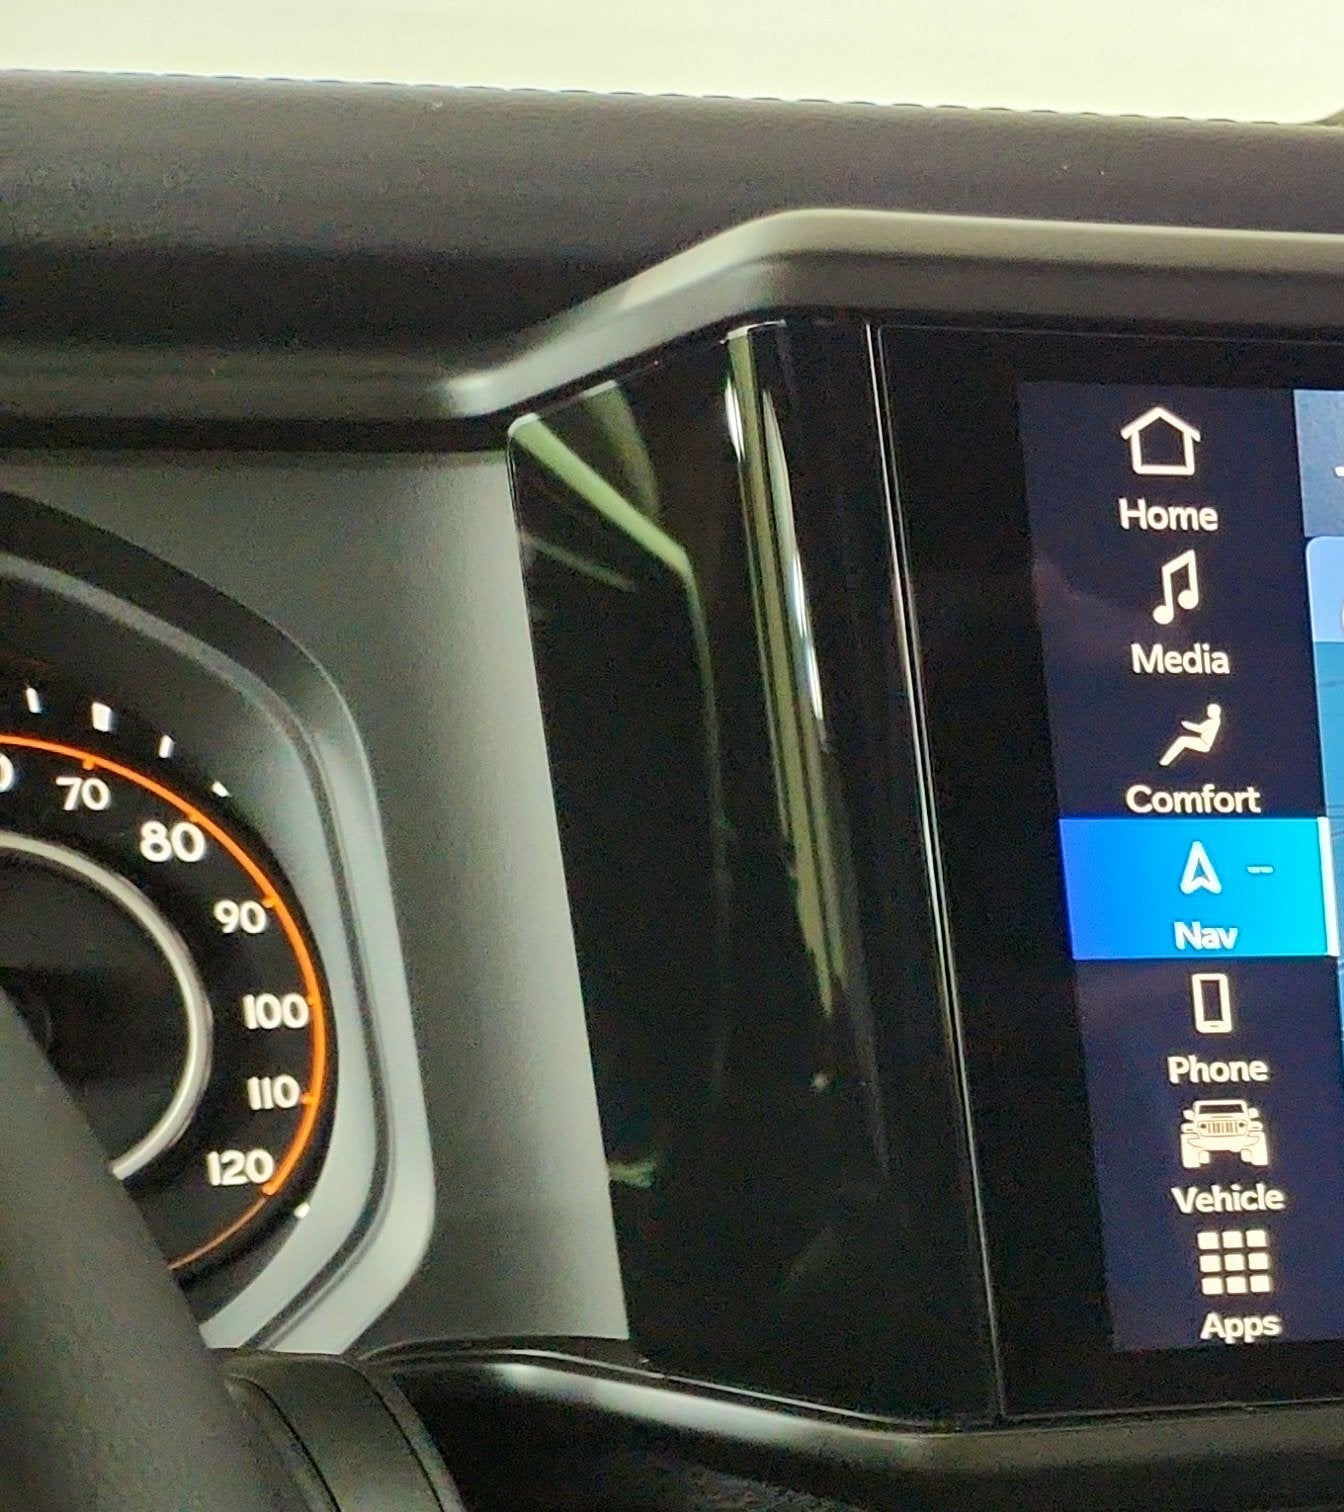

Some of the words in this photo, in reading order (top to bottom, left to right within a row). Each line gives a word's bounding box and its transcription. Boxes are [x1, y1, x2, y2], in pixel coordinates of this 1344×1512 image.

[1118, 498, 1219, 533] Home
[1131, 643, 1230, 676] Media
[56, 777, 112, 812] 70
[1125, 784, 1261, 815] Comfort
[140, 820, 206, 863] 80
[214, 899, 268, 935] 90
[1173, 923, 1239, 952] Nav
[244, 994, 310, 1031] 100
[1167, 1055, 1270, 1086] Phone
[248, 1075, 301, 1112] 110
[207, 1150, 274, 1187] 120
[1171, 1185, 1286, 1215] Vehicle
[1200, 1312, 1283, 1344] Apps
